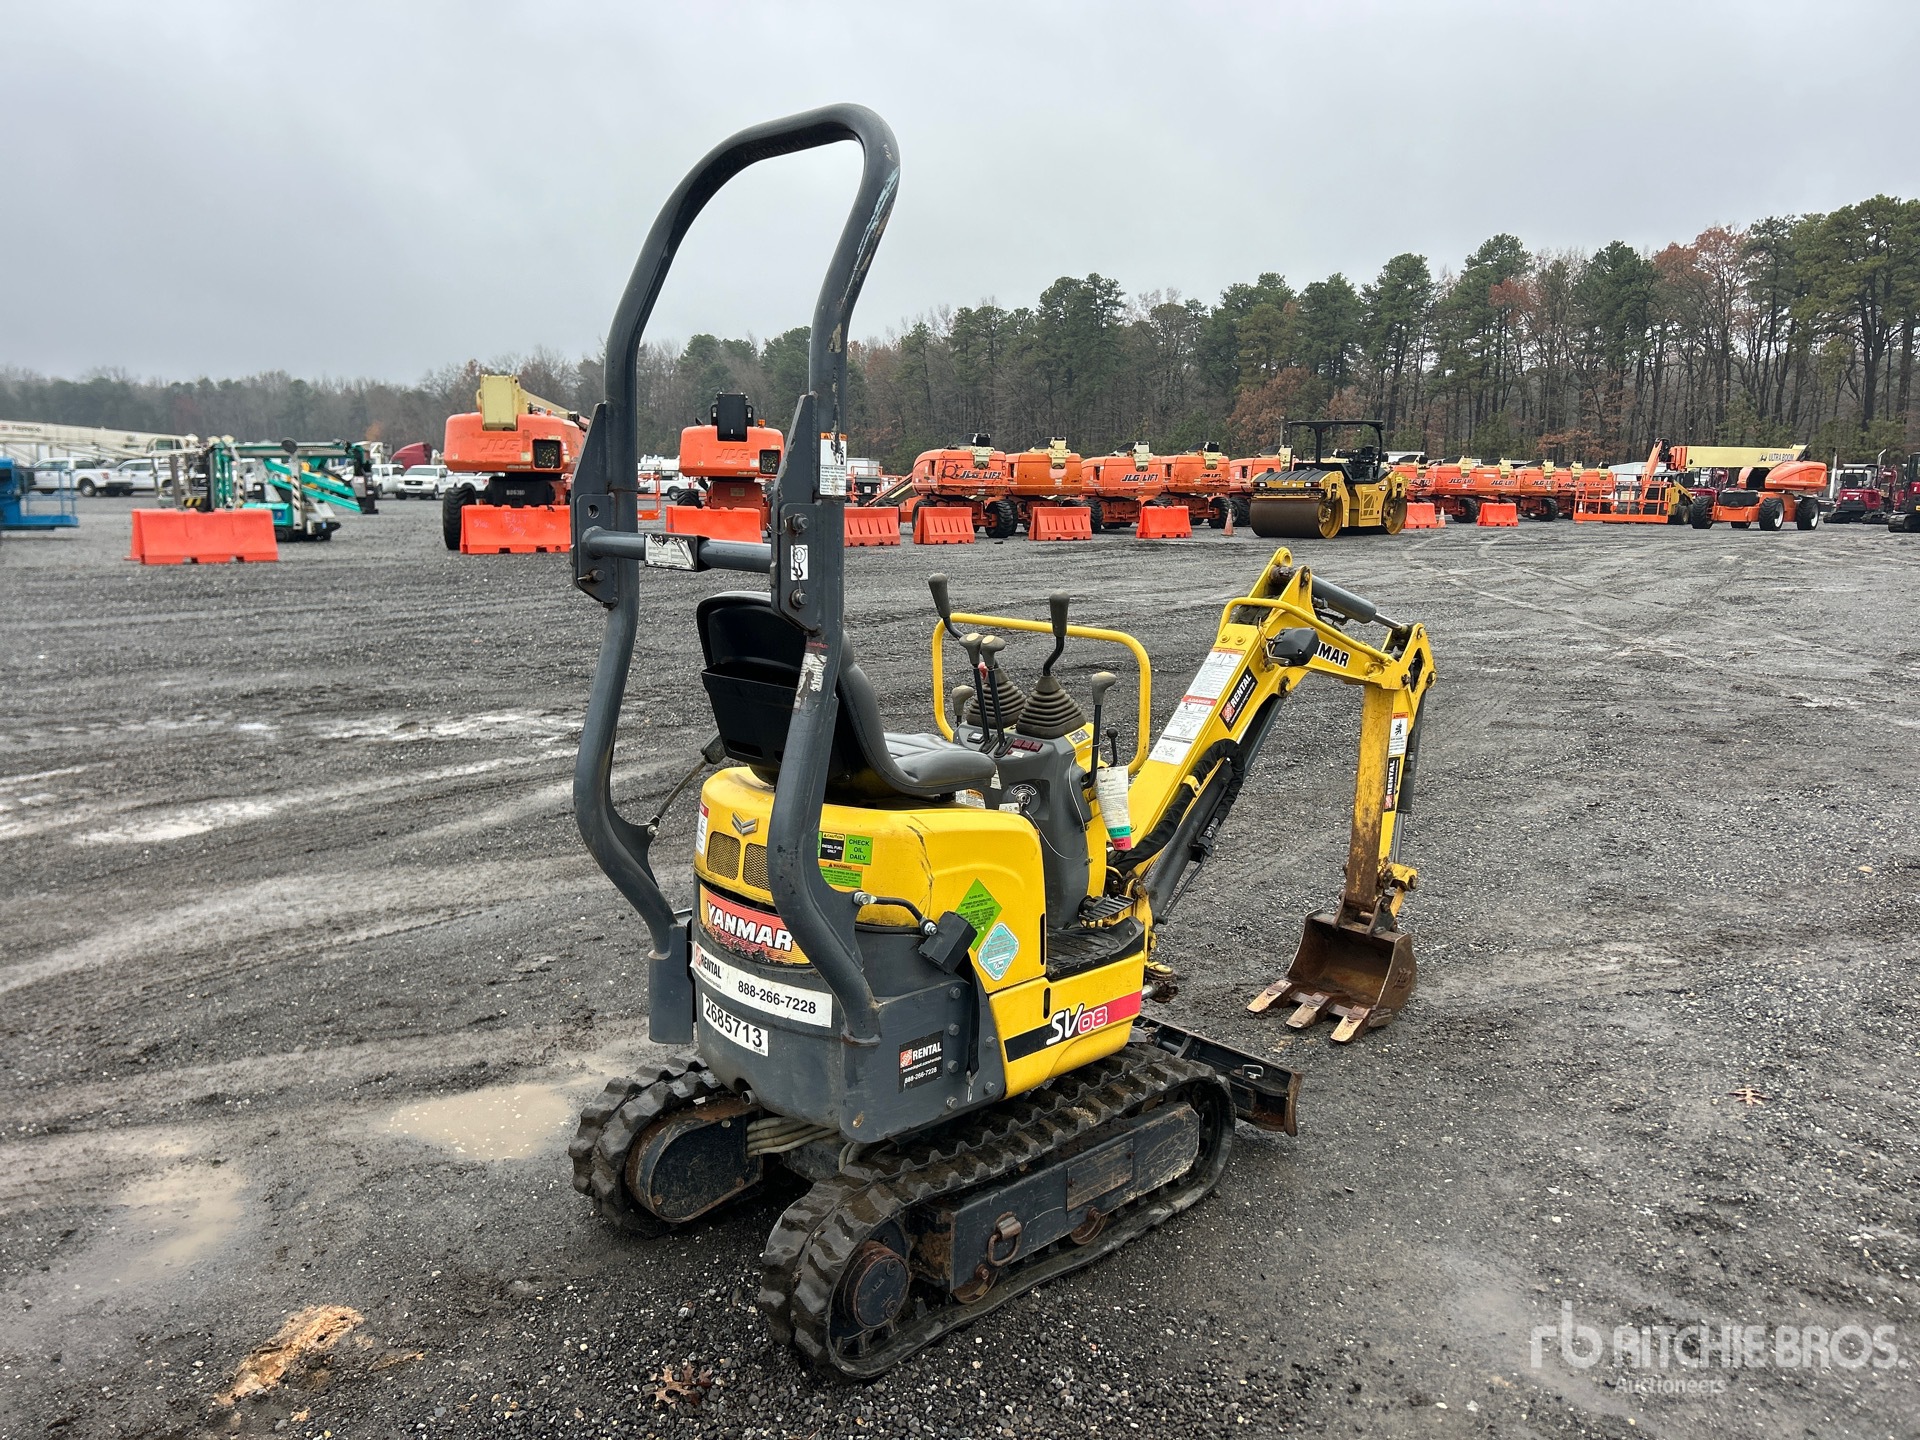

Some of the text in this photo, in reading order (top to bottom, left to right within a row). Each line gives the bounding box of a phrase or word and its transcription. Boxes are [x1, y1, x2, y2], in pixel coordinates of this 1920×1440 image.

[480, 439, 521, 453] JLG
[1122, 474, 1159, 482] JLG LIFT
[1316, 642, 1349, 667] MAR
[1230, 673, 1252, 708] RENTAL
[1387, 760, 1396, 795] RENTAL
[848, 839, 870, 847] CHECK
[853, 846, 864, 854] OIL
[849, 853, 867, 861] DAILY
[706, 901, 794, 952] YANMAR
[701, 954, 722, 979] RENTAL
[738, 980, 816, 1015] 888-266-7228
[705, 998, 763, 1048] 2685713
[1046, 1003, 1109, 1046] SV08
[913, 1041, 942, 1061] RENTAL
[904, 1066, 937, 1084] 888-266-7228
